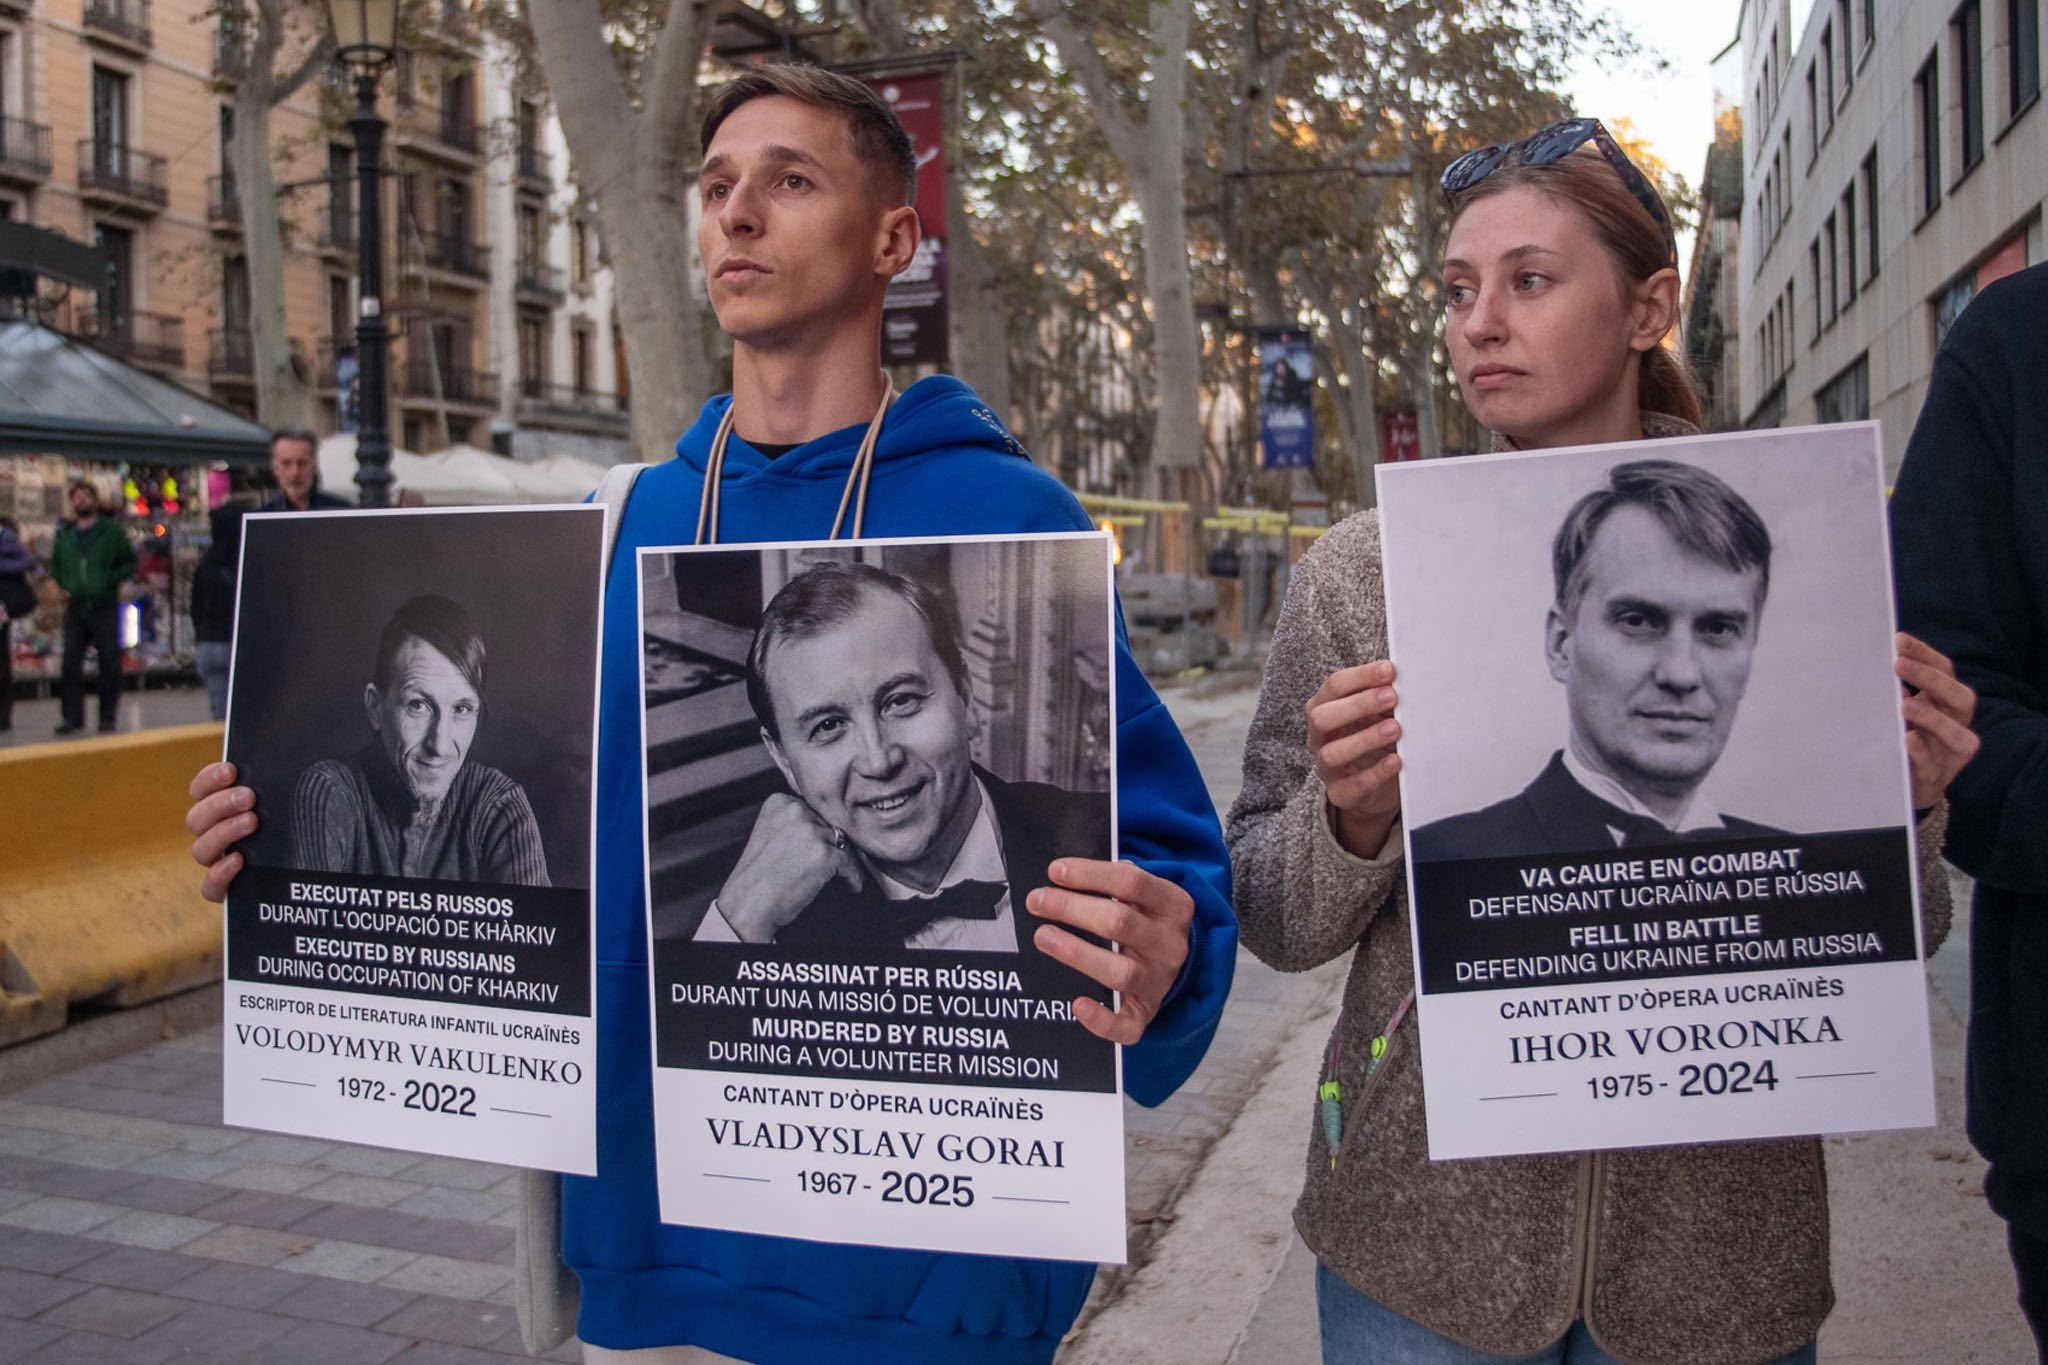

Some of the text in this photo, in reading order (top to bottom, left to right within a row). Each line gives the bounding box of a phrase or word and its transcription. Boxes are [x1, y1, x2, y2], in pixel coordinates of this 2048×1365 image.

[1520, 848, 1800, 888] VA CAURE EN COMBAT
[291, 882, 514, 917] EXECUTAT PELS RUSSOS
[1469, 869, 1864, 920] DEFENSANT UCRAÏNA DE RÚSSIA
[259, 903, 556, 945] DURANT L'OCUPACIÓ DE KHÀRKIV
[1569, 914, 1759, 947] FELL IN BATTLE
[296, 936, 516, 973] EXECUTED BY RUSSIANS
[1456, 931, 1881, 982] DEFENDING UKRAINE FROM RUSSIA
[258, 955, 559, 1002] DURING OCCUPATION OF KHARKIV
[737, 960, 1022, 991] ASSASSINAT PER RÚSSIA
[671, 984, 1105, 1021] DURANT UNA MISSIÓ DE VOLUNTARI
[1500, 978, 1844, 1020] CANTANT D'ÒPERA UCRAÏNÈS
[239, 994, 581, 1045] ESCRIPTOR DE LITERATURA INFANTIL UCRAÏNÈS
[752, 1017, 1010, 1049] MURDERED BY RUSSIA
[1509, 1014, 1842, 1065] IHOR VORONKA
[235, 1023, 582, 1084] VOLODYMYR VAKULENKO
[709, 1041, 1059, 1079] DURING A VOLUNTEER MISSION
[338, 1076, 385, 1101] 1972
[404, 1079, 477, 1116] 2022
[1587, 1072, 1653, 1100] 1975
[1678, 1060, 1778, 1098] 2024
[724, 1085, 1043, 1121] CANTANT D'ÒPERA UCRAÏNÈS
[706, 1117, 1065, 1168] VLADYSLAV GORAI
[797, 1170, 856, 1195] 1967
[881, 1170, 975, 1208] 2025
